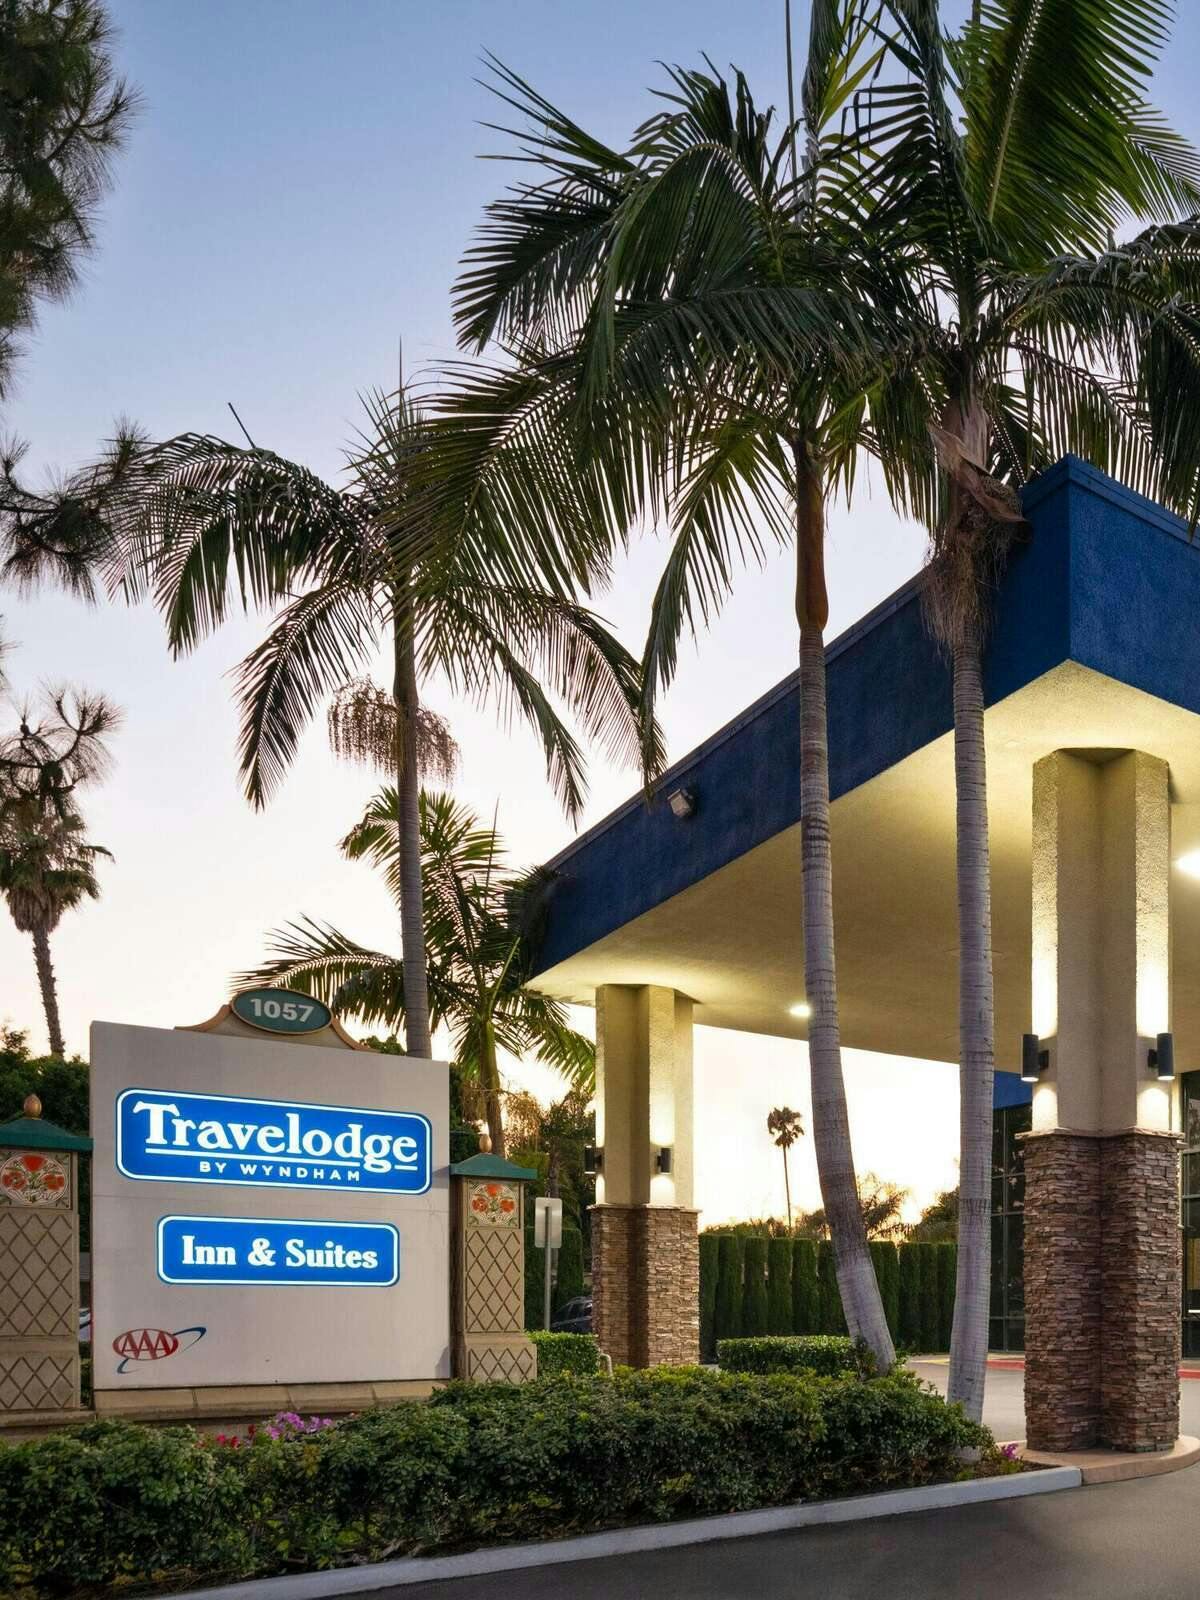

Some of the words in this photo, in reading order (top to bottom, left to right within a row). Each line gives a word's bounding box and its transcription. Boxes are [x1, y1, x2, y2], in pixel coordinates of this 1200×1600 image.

[250, 998, 314, 1023] 1057
[133, 1100, 418, 1173] Travelodge
[199, 1161, 228, 1174] BY
[240, 1164, 360, 1182] WYNDHAM
[181, 1235, 236, 1266] Inn
[247, 1238, 276, 1267] &
[286, 1239, 379, 1269] Suites
[120, 1329, 172, 1360] AAA
